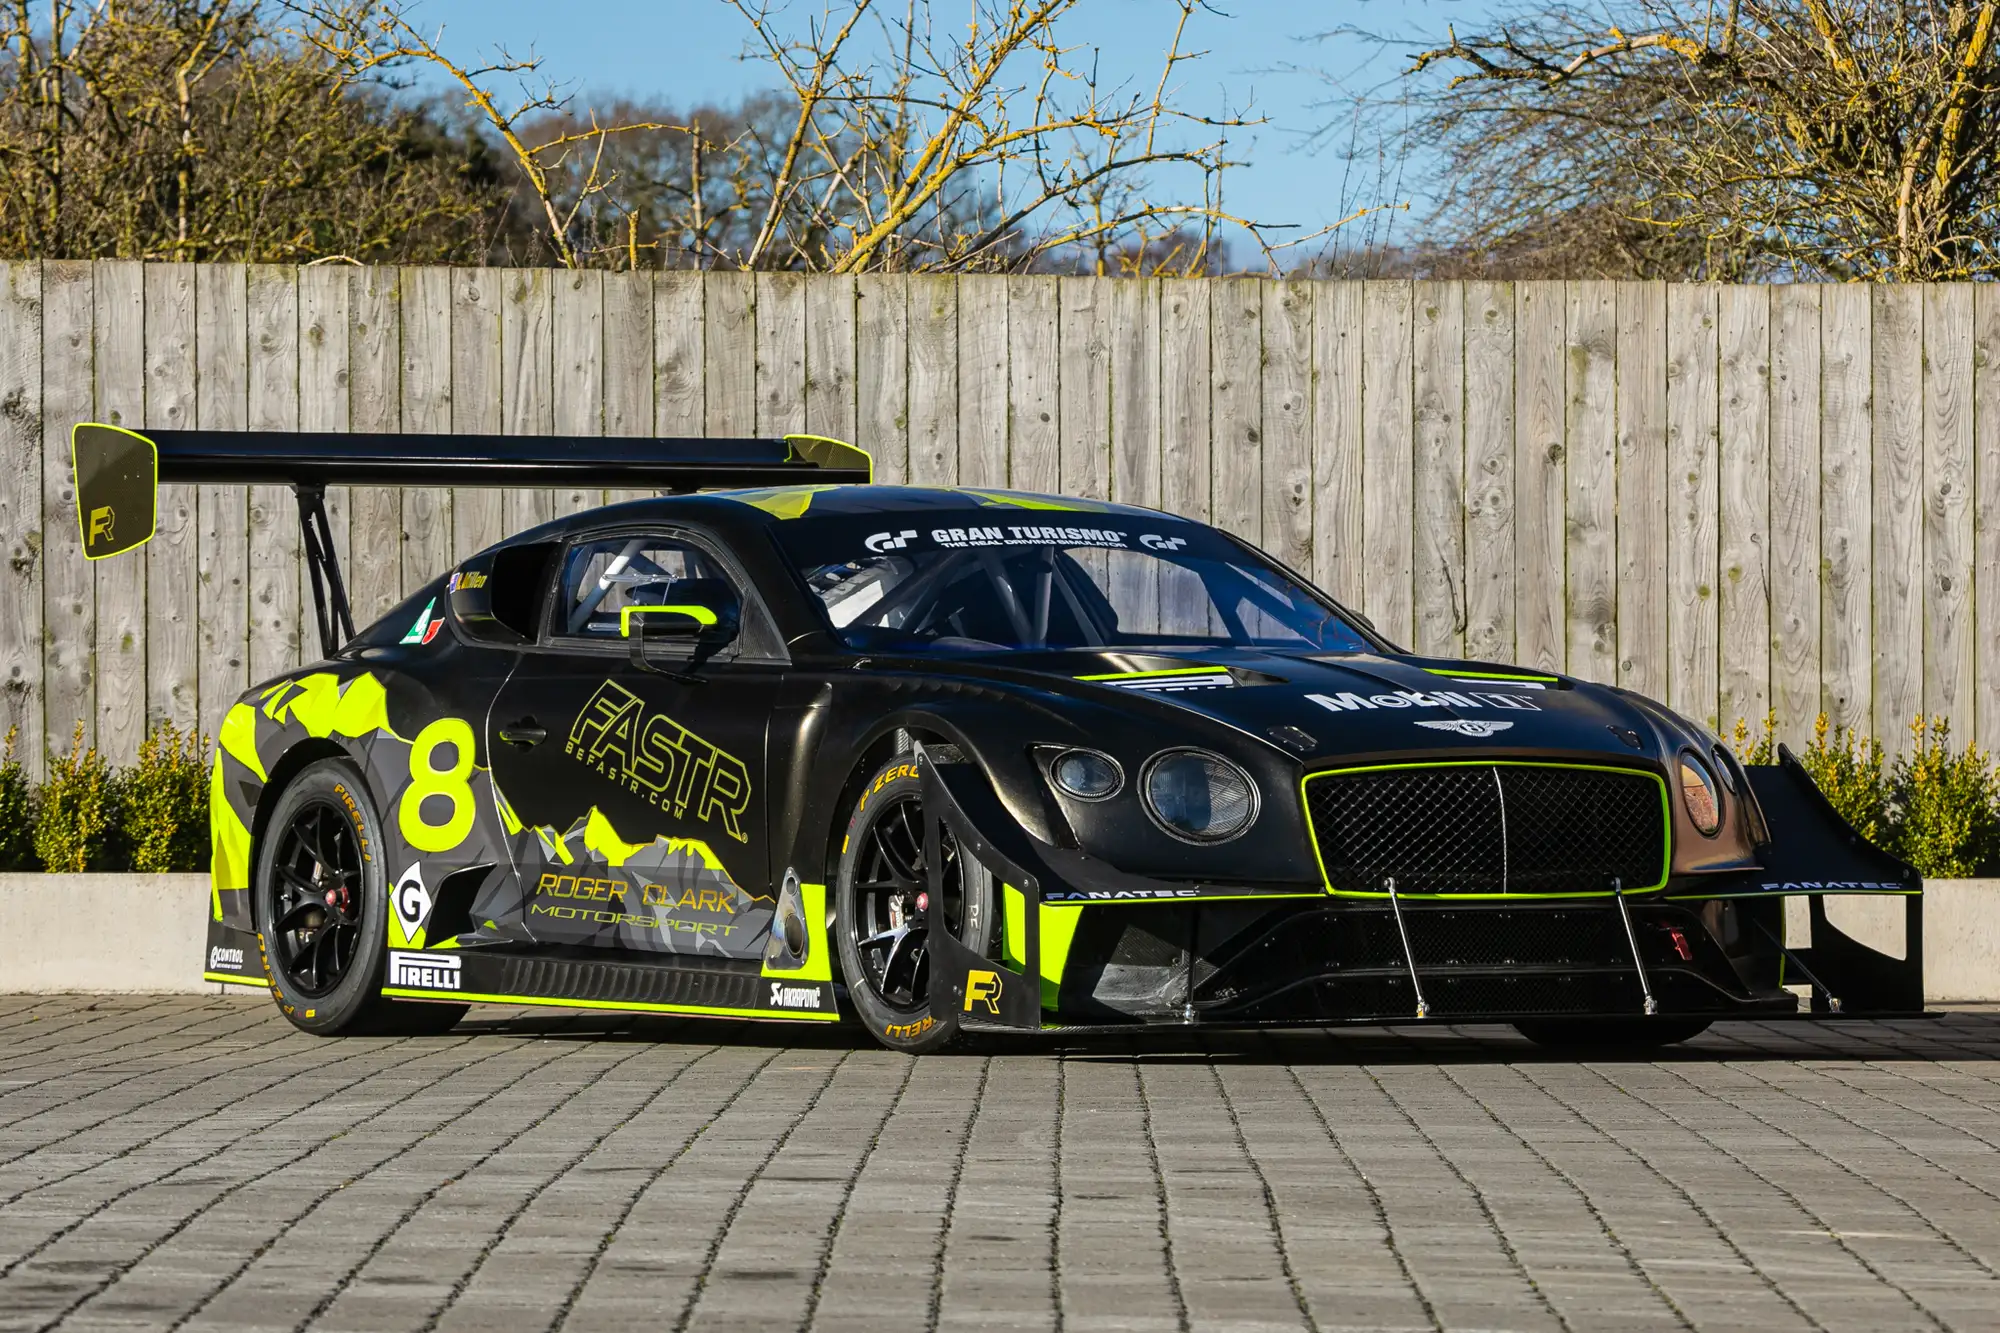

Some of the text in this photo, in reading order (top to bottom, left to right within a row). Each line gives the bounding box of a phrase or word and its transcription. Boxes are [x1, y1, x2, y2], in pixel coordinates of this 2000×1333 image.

[931, 526, 1004, 543] GRAN
[1059, 539, 1129, 549] SIMULATOR
[1303, 691, 1483, 712] Mobil
[398, 717, 476, 852] 8
[565, 741, 684, 819] BEFASTR.COM
[334, 782, 372, 863] PIRELLI
[399, 879, 421, 923] G
[536, 873, 735, 914] ROGER CLARK
[1046, 889, 1196, 900] FANATEC
[1761, 881, 1901, 890] FANATEC
[531, 904, 739, 936] MOTORSPORT
[390, 951, 462, 990] PIRELLI
